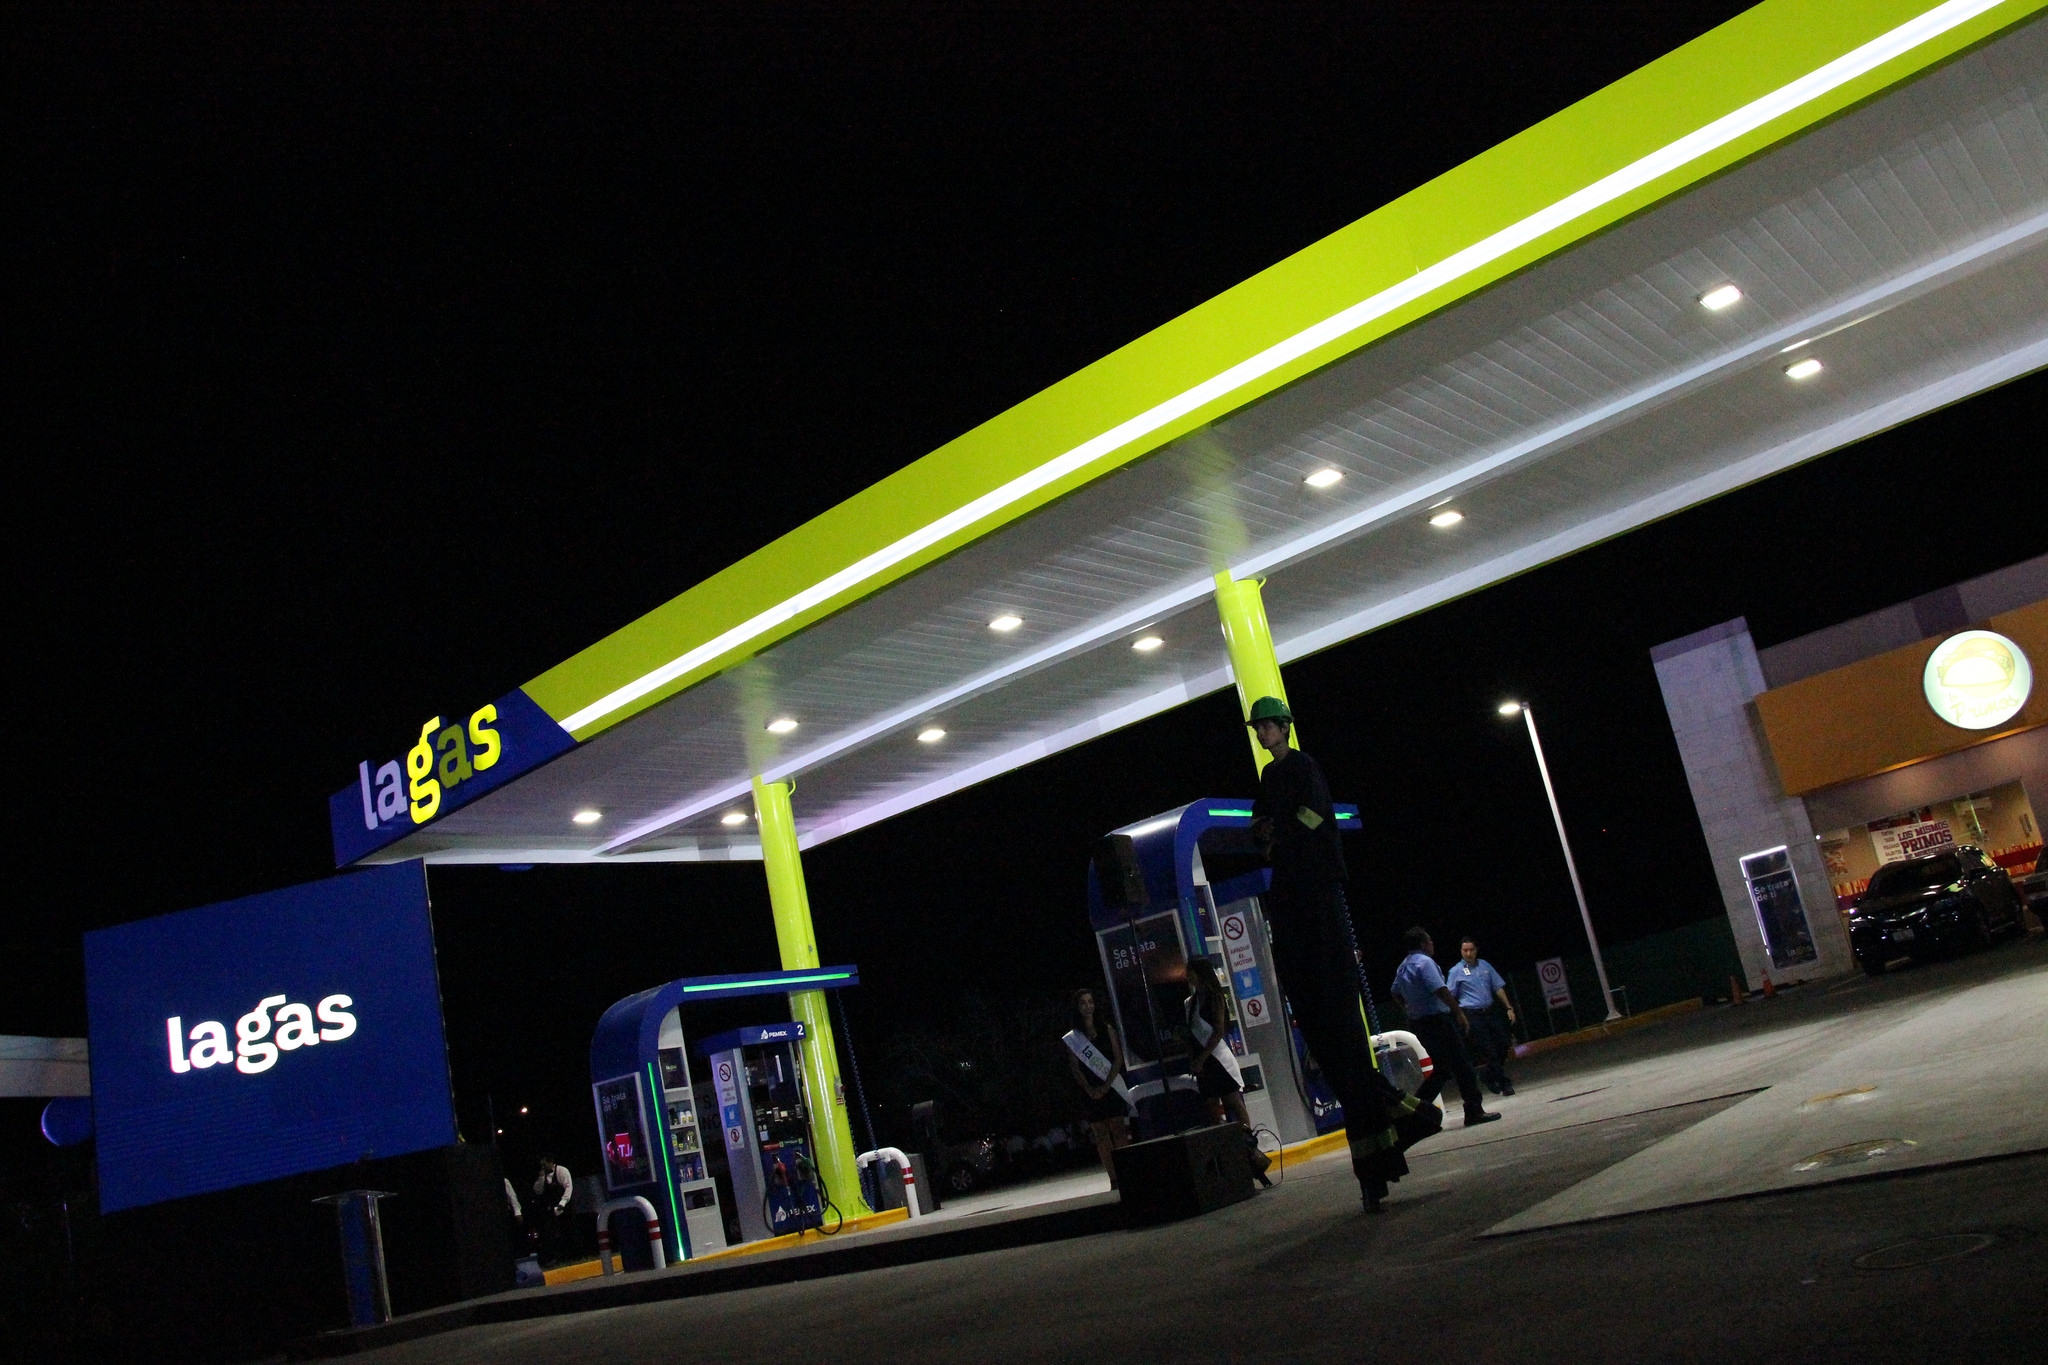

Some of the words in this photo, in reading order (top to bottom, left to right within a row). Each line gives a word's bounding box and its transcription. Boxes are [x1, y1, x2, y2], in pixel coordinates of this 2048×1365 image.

[358, 703, 502, 831] lagas
[1898, 830, 1914, 842] LOS
[1915, 820, 1949, 836] MISMOS
[1900, 829, 1953, 854] PRIMOS
[1113, 948, 1128, 960] Se
[1129, 940, 1156, 955] tata
[1115, 957, 1130, 970] de
[1233, 957, 1253, 967] MOTOR
[1545, 966, 1557, 977] 10
[166, 993, 358, 1075] lagas
[768, 1030, 788, 1039] PEMEX
[796, 1024, 805, 1036] 2
